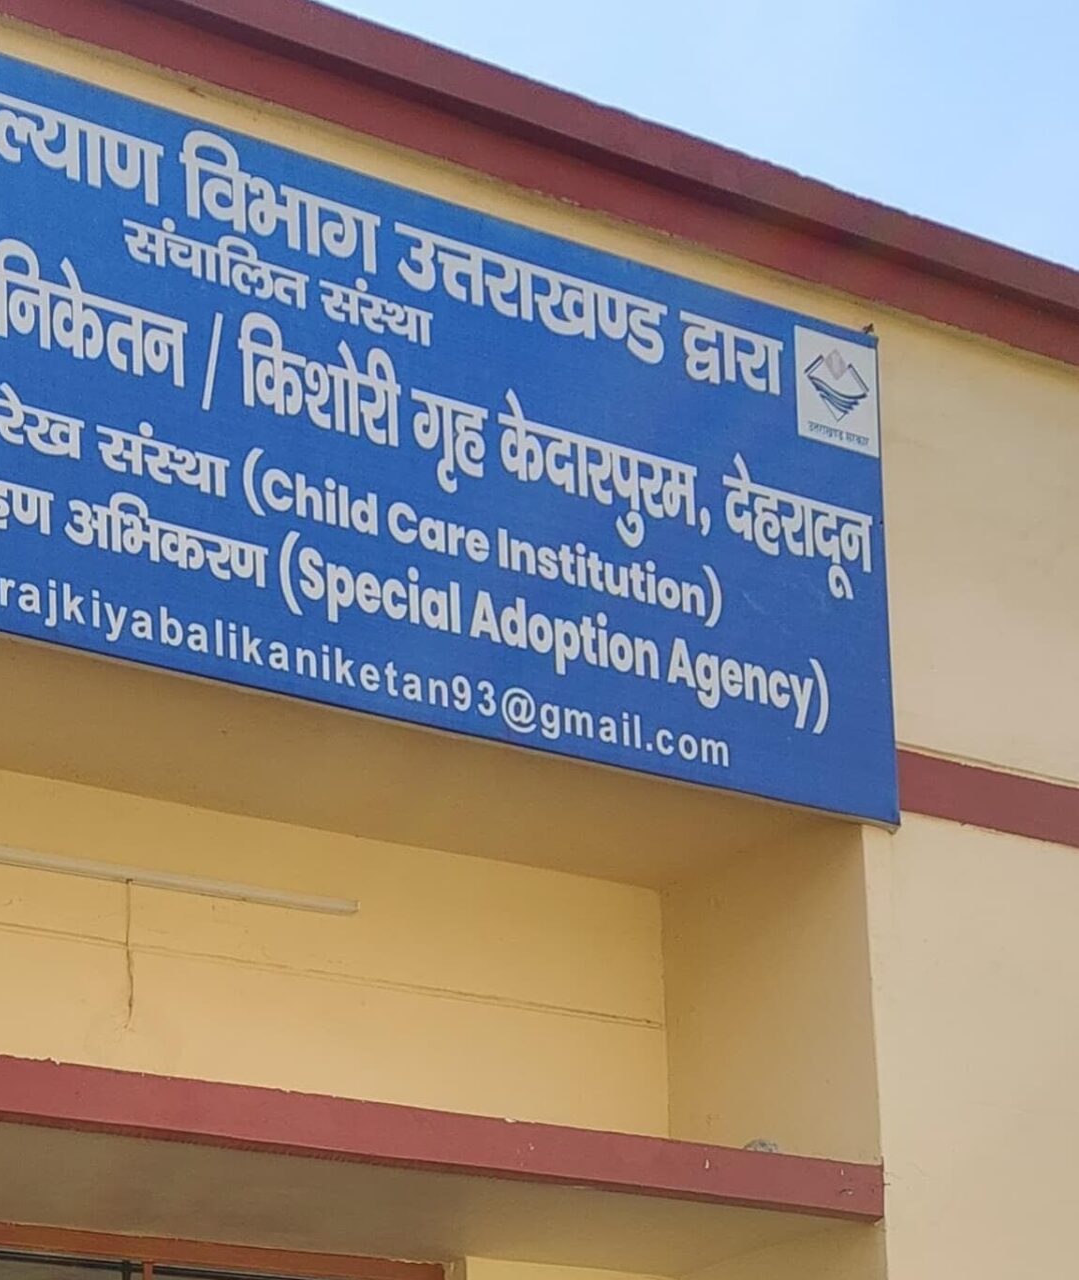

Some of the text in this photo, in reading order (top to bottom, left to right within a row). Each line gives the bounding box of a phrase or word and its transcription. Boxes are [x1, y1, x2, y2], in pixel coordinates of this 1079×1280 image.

[123, 218, 433, 346] संचालित संस्था
[179, 130, 380, 274] विभाग
[395, 221, 667, 364] उत्तराखण्ड
[680, 311, 783, 396] द्वारा
[96, 421, 230, 498] संस्था
[243, 447, 379, 536] (Child
[387, 501, 490, 562] Care
[498, 528, 722, 628] Institution)
[238, 312, 401, 447] किशोरी
[411, 387, 488, 493] गृह
[499, 388, 712, 548] केदारपुरम,
[723, 452, 873, 600] देहरादून
[0, 576, 730, 768] rajkiyabalikaniketan93@gmail.com
[64, 491, 269, 588] अभिकरण
[279, 530, 462, 635] (Special
[470, 590, 660, 680] Adoption
[667, 637, 829, 735] Agency)
